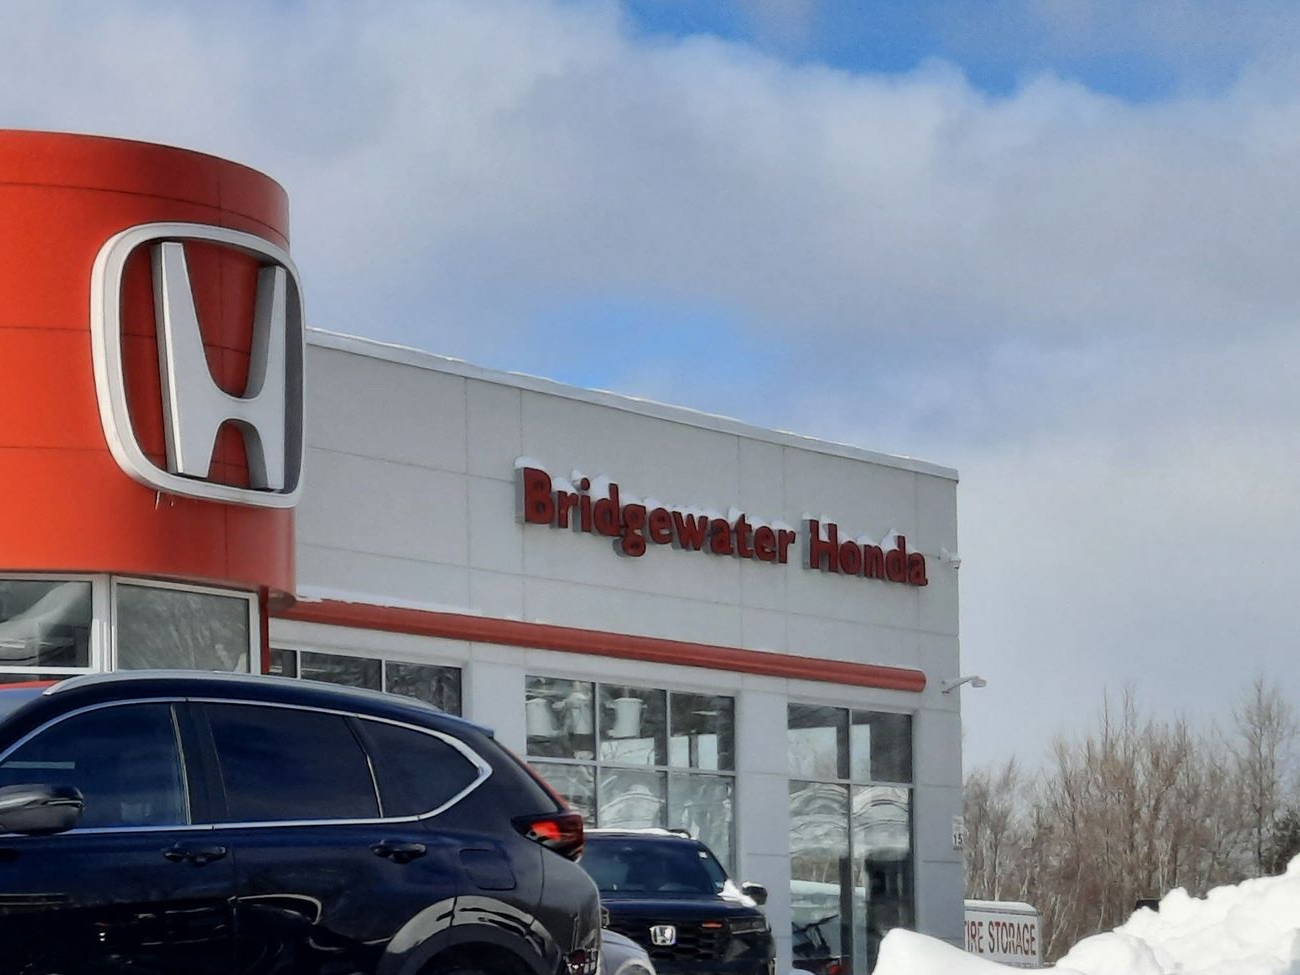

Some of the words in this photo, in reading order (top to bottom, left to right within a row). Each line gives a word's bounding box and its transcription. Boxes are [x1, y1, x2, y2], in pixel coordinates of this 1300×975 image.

[518, 466, 796, 564] Bridgewater
[806, 518, 928, 586] Honda
[988, 920, 1036, 955] STORAGE
